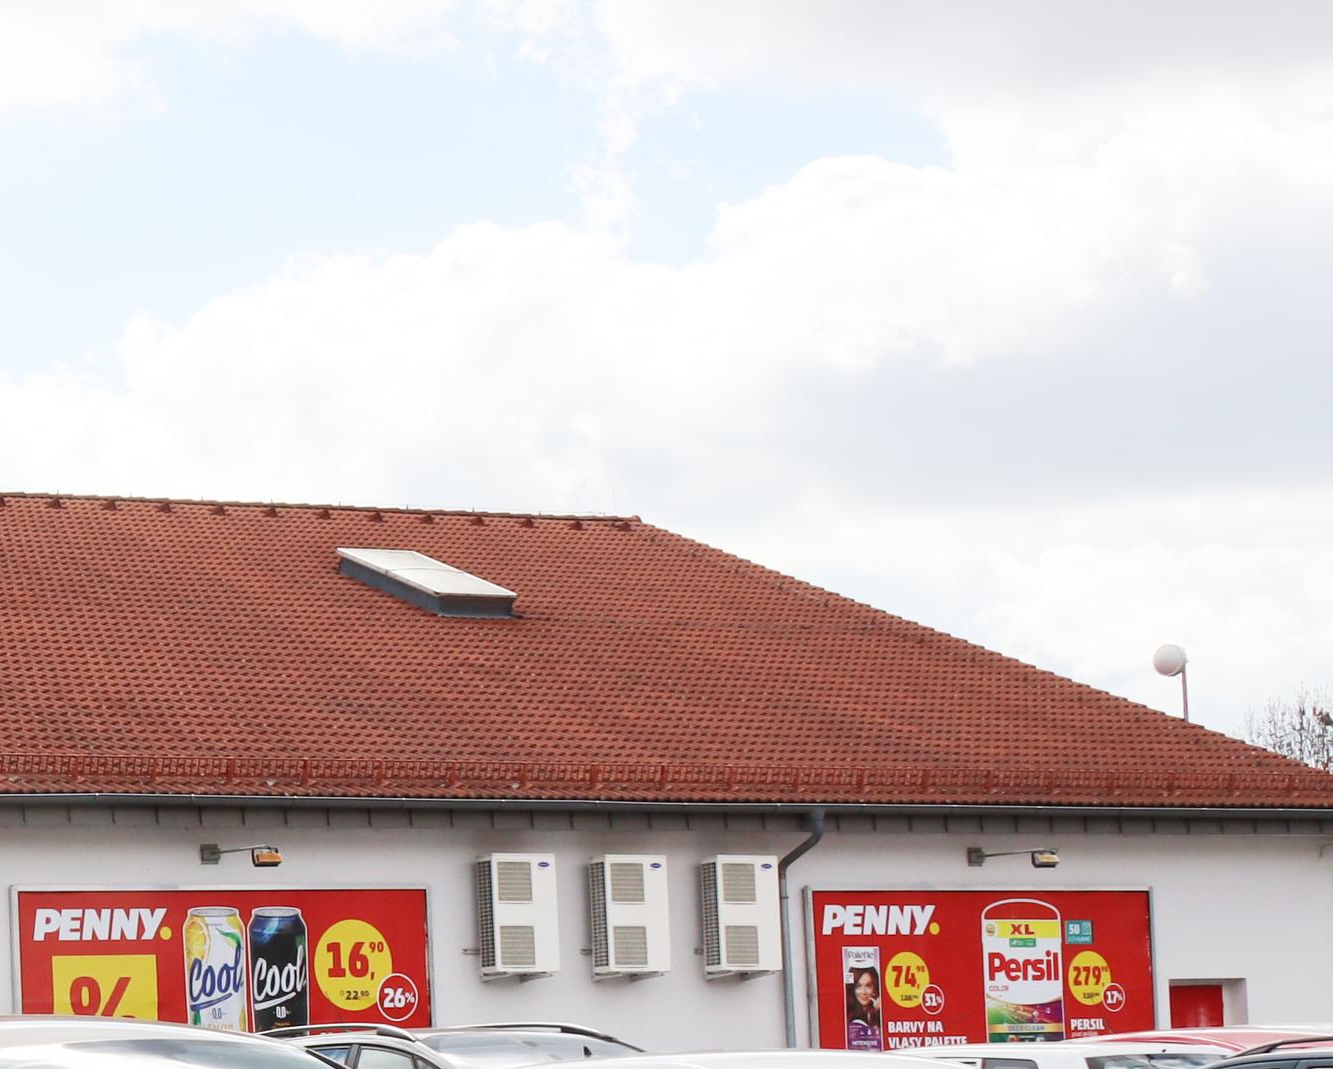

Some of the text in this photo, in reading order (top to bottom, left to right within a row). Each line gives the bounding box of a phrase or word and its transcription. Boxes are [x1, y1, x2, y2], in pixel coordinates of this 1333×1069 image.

[1010, 923, 1036, 936] XL
[987, 949, 1060, 982] Persil
[383, 987, 415, 1009] 26%
[888, 1020, 944, 1034] BARVY NA
[1070, 1018, 1105, 1031] PERSIL
[888, 1036, 925, 1049] VLASY
